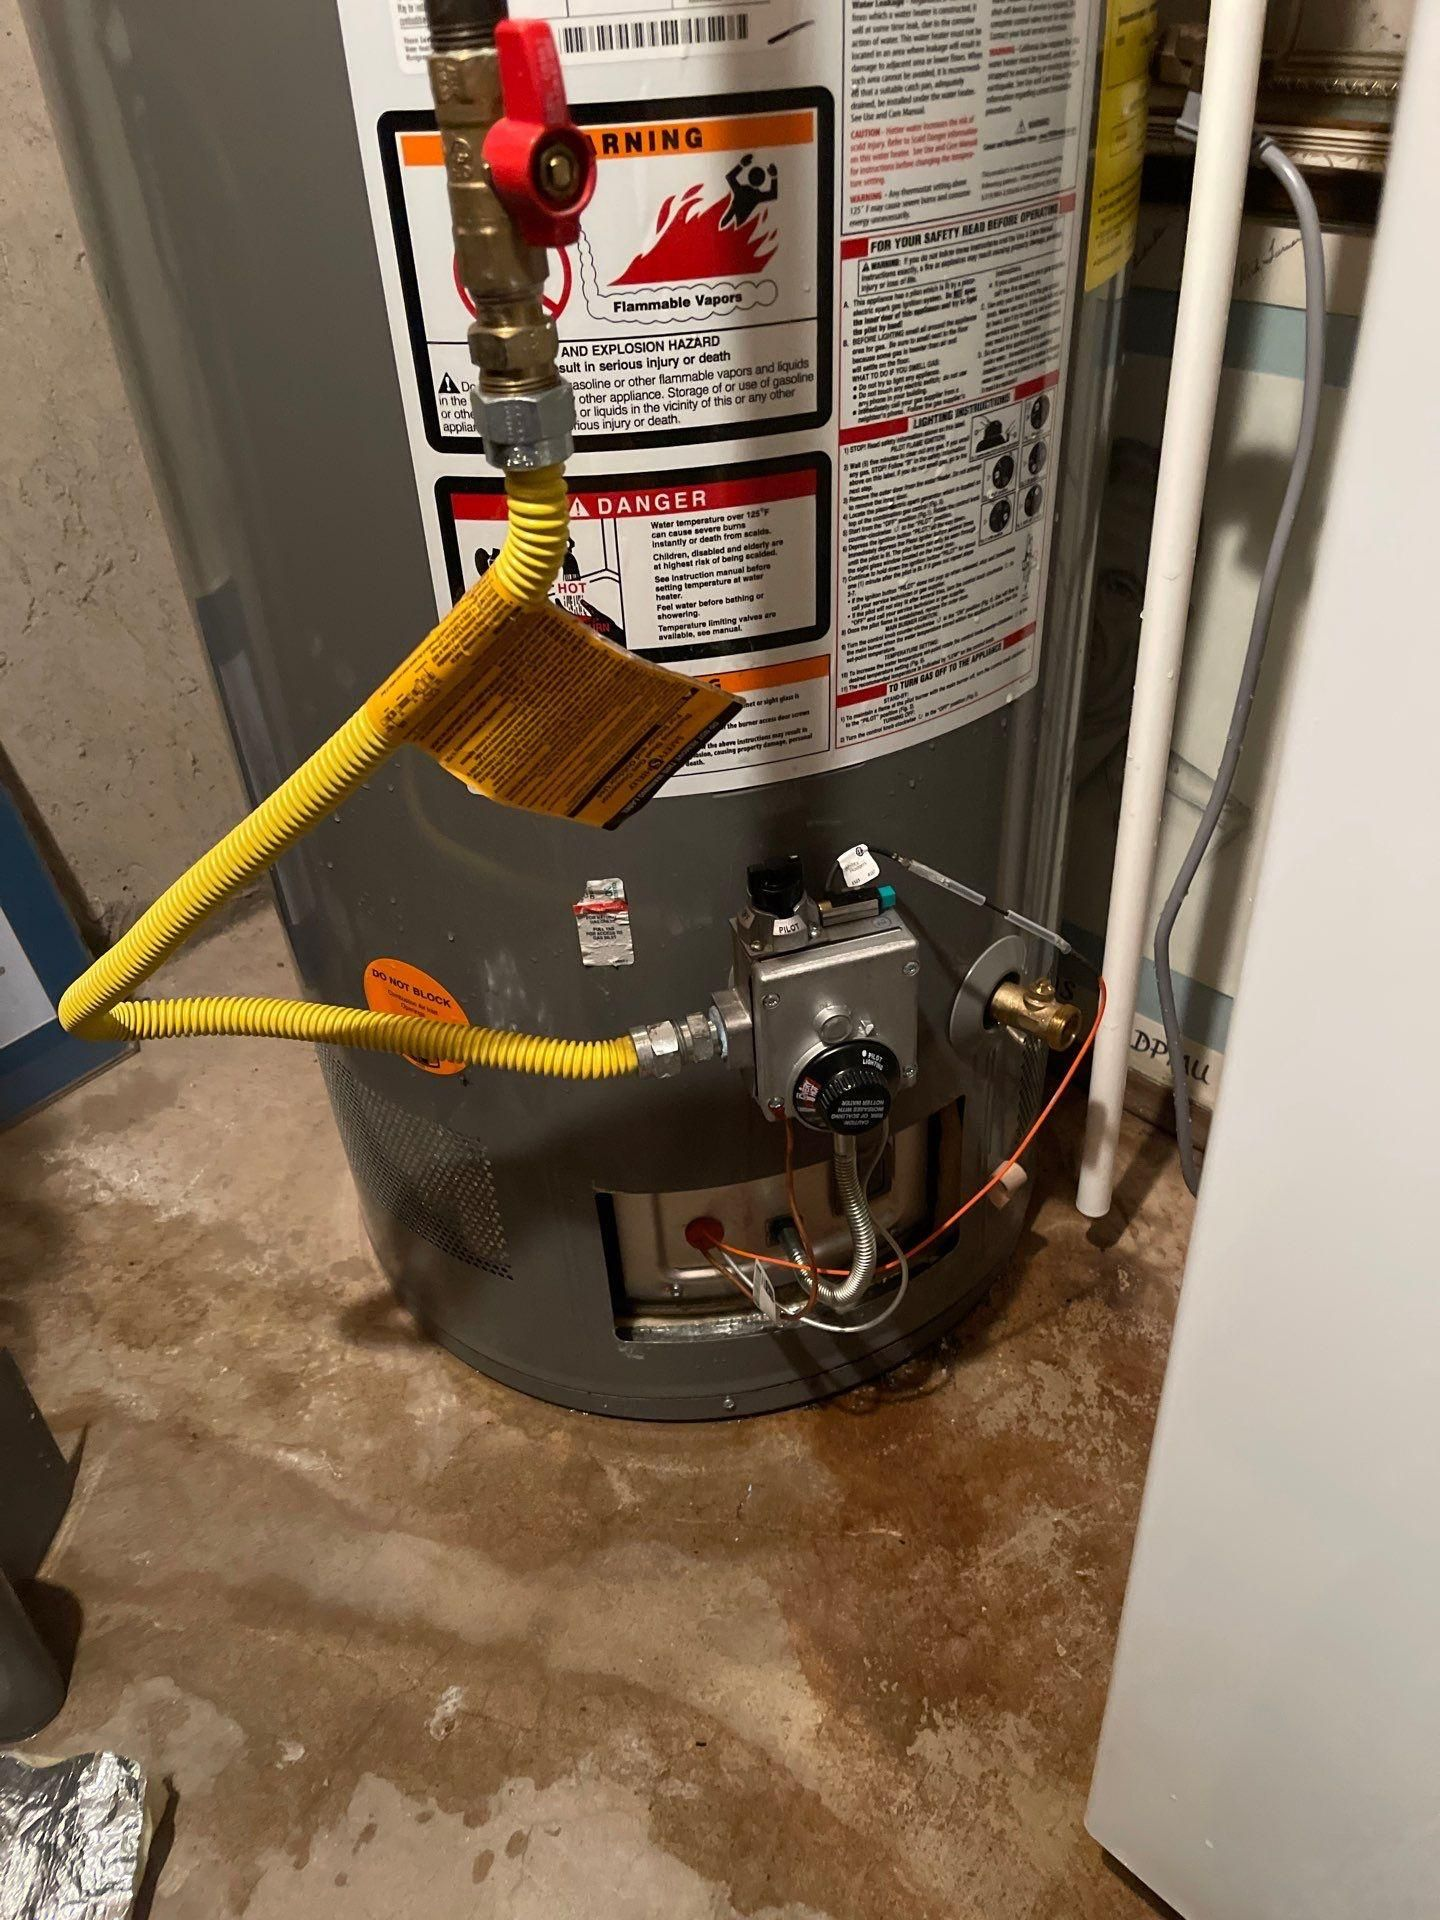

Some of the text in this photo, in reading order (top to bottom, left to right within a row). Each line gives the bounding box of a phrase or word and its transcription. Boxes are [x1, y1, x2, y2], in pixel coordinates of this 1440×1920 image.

[590, 127, 702, 157] RNING
[851, 129, 880, 139] CAUTION
[871, 203, 1058, 253] FOR YOUR SAFETY READ BEFORE OPERATING
[613, 293, 742, 313] Flammable Vapors
[562, 336, 720, 357] AND EXPLOSION HAZARD
[559, 352, 730, 373] sult in serious injury or death
[570, 359, 809, 390] asoline or other flammable vapors and liquids
[579, 373, 814, 404] other appliance. Storage of or use of gasoline
[440, 397, 467, 405] in the
[580, 388, 795, 419] or liquids in the vicinity of this or any other
[913, 394, 1010, 429] LIGHTING INSTRUCTIONS
[444, 422, 476, 434] applia
[572, 413, 680, 431] rious injury or death.
[598, 490, 706, 515] DANGER
[650, 520, 674, 529] Water
[676, 516, 724, 528] temperature
[727, 513, 744, 521] over
[669, 528, 693, 536] cause
[695, 525, 721, 534] severe
[723, 522, 746, 531] burns
[700, 533, 721, 542] death
[723, 531, 742, 540] from
[744, 528, 771, 537] scalds.
[653, 553, 689, 561] Children,
[692, 547, 725, 557] disabled
[727, 545, 741, 553] and
[744, 542, 769, 551] elderly
[663, 561, 693, 571] highest
[695, 558, 709, 566] risk
[712, 556, 720, 564] of
[722, 554, 743, 564] being
[745, 550, 777, 559] scalded.
[716, 568, 744, 576] manual
[746, 564, 770, 573] before
[558, 583, 586, 593] HOT
[656, 584, 682, 592] setting
[685, 579, 731, 589] temperature
[743, 574, 764, 582] water
[656, 593, 682, 601] heater.
[699, 599, 723, 607] before
[726, 595, 754, 604] bathing
[658, 611, 700, 620] showering.
[659, 622, 706, 632] Temperature
[708, 617, 737, 627] limiting
[739, 613, 762, 622] valves
[659, 632, 695, 641] available,
[713, 625, 742, 634] manual.
[889, 644, 1001, 693] TO TURN GAS OFF TO THE APPLIANCE
[764, 697, 778, 705] sight
[780, 695, 793, 703] glass
[792, 710, 810, 719] screws
[714, 747, 736, 756] causing
[737, 744, 761, 753] property
[763, 739, 787, 748] damage,
[789, 733, 812, 744] personal
[737, 734, 770, 745] instructions
[779, 923, 800, 933] PILOT
[372, 969, 386, 981] DO
[389, 977, 409, 991] NOT
[413, 987, 451, 1008] BLOCK
[863, 1059, 883, 1070] LIGHTING
[868, 1052, 882, 1062] PILOT
